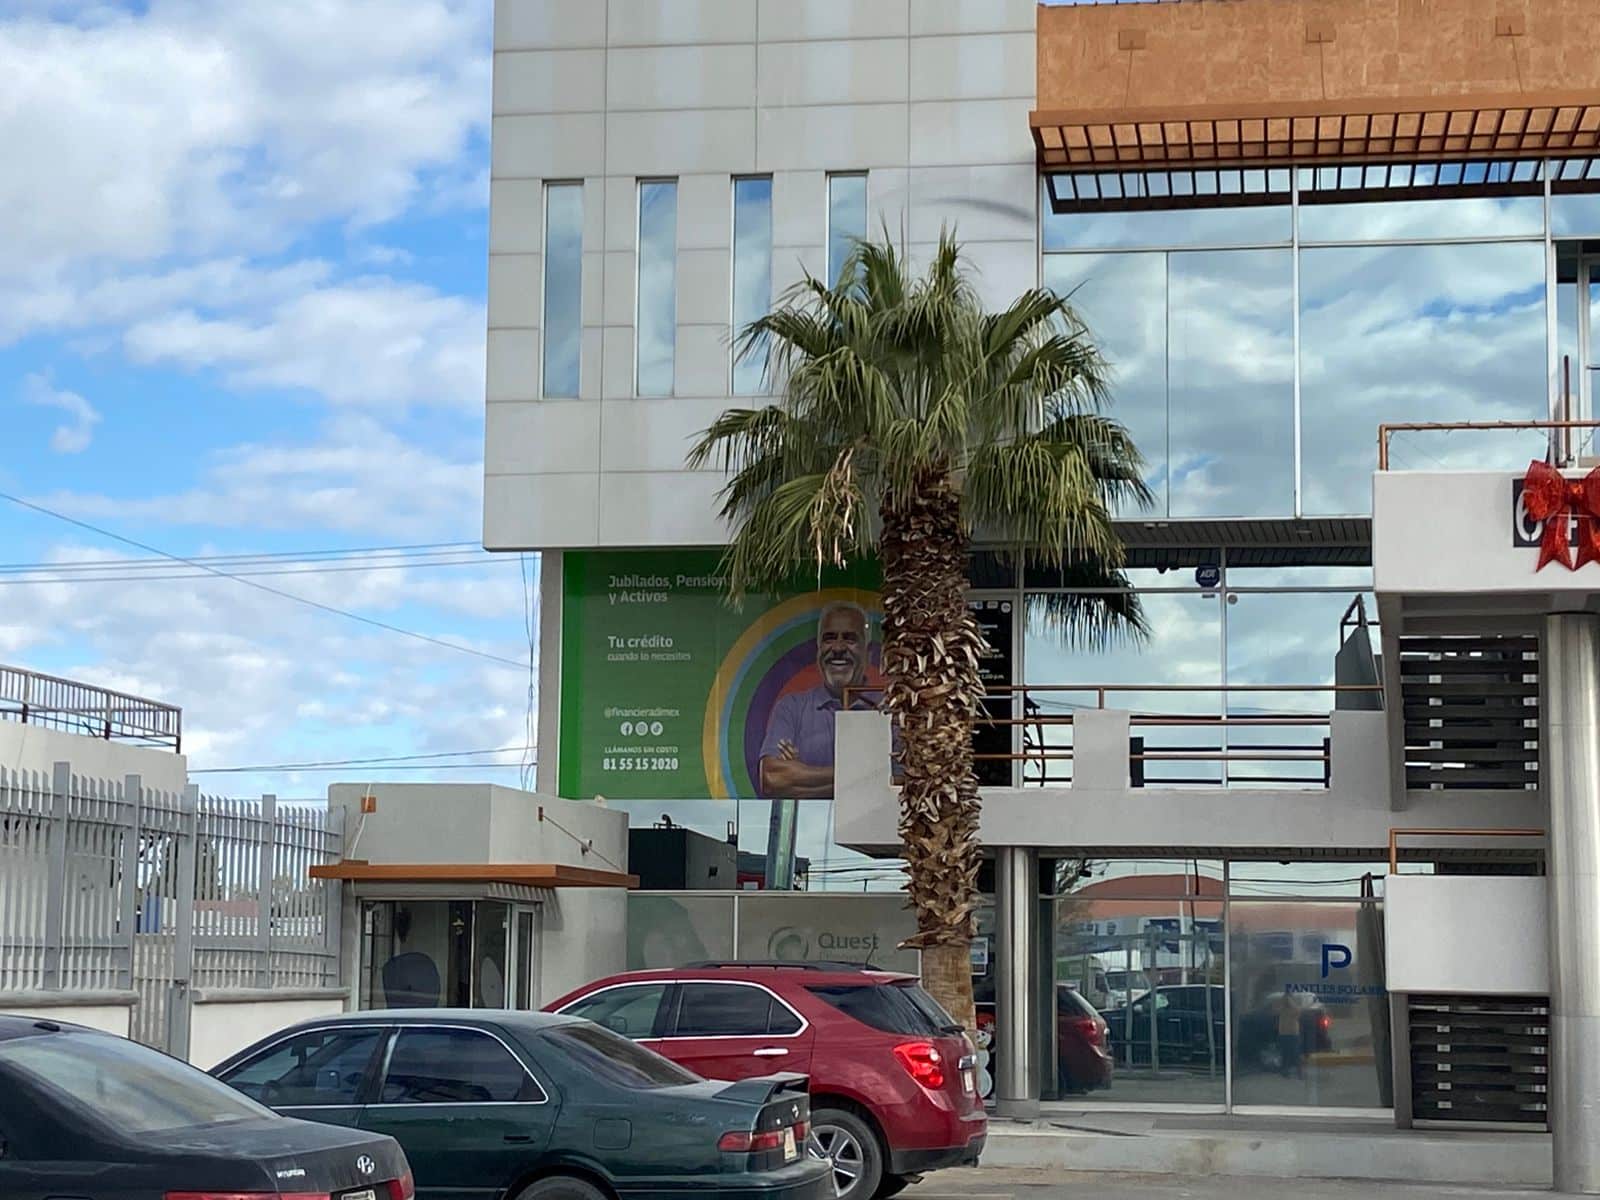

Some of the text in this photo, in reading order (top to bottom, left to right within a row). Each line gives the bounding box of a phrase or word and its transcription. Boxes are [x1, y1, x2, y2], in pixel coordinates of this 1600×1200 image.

[608, 574, 758, 589] Jubilados, Pensiono
[608, 590, 668, 605] y Activos
[608, 634, 673, 648] Tu crédito
[603, 758, 678, 770] 81 55 15 2020
[818, 932, 879, 950] Quest
[1321, 943, 1353, 978] P
